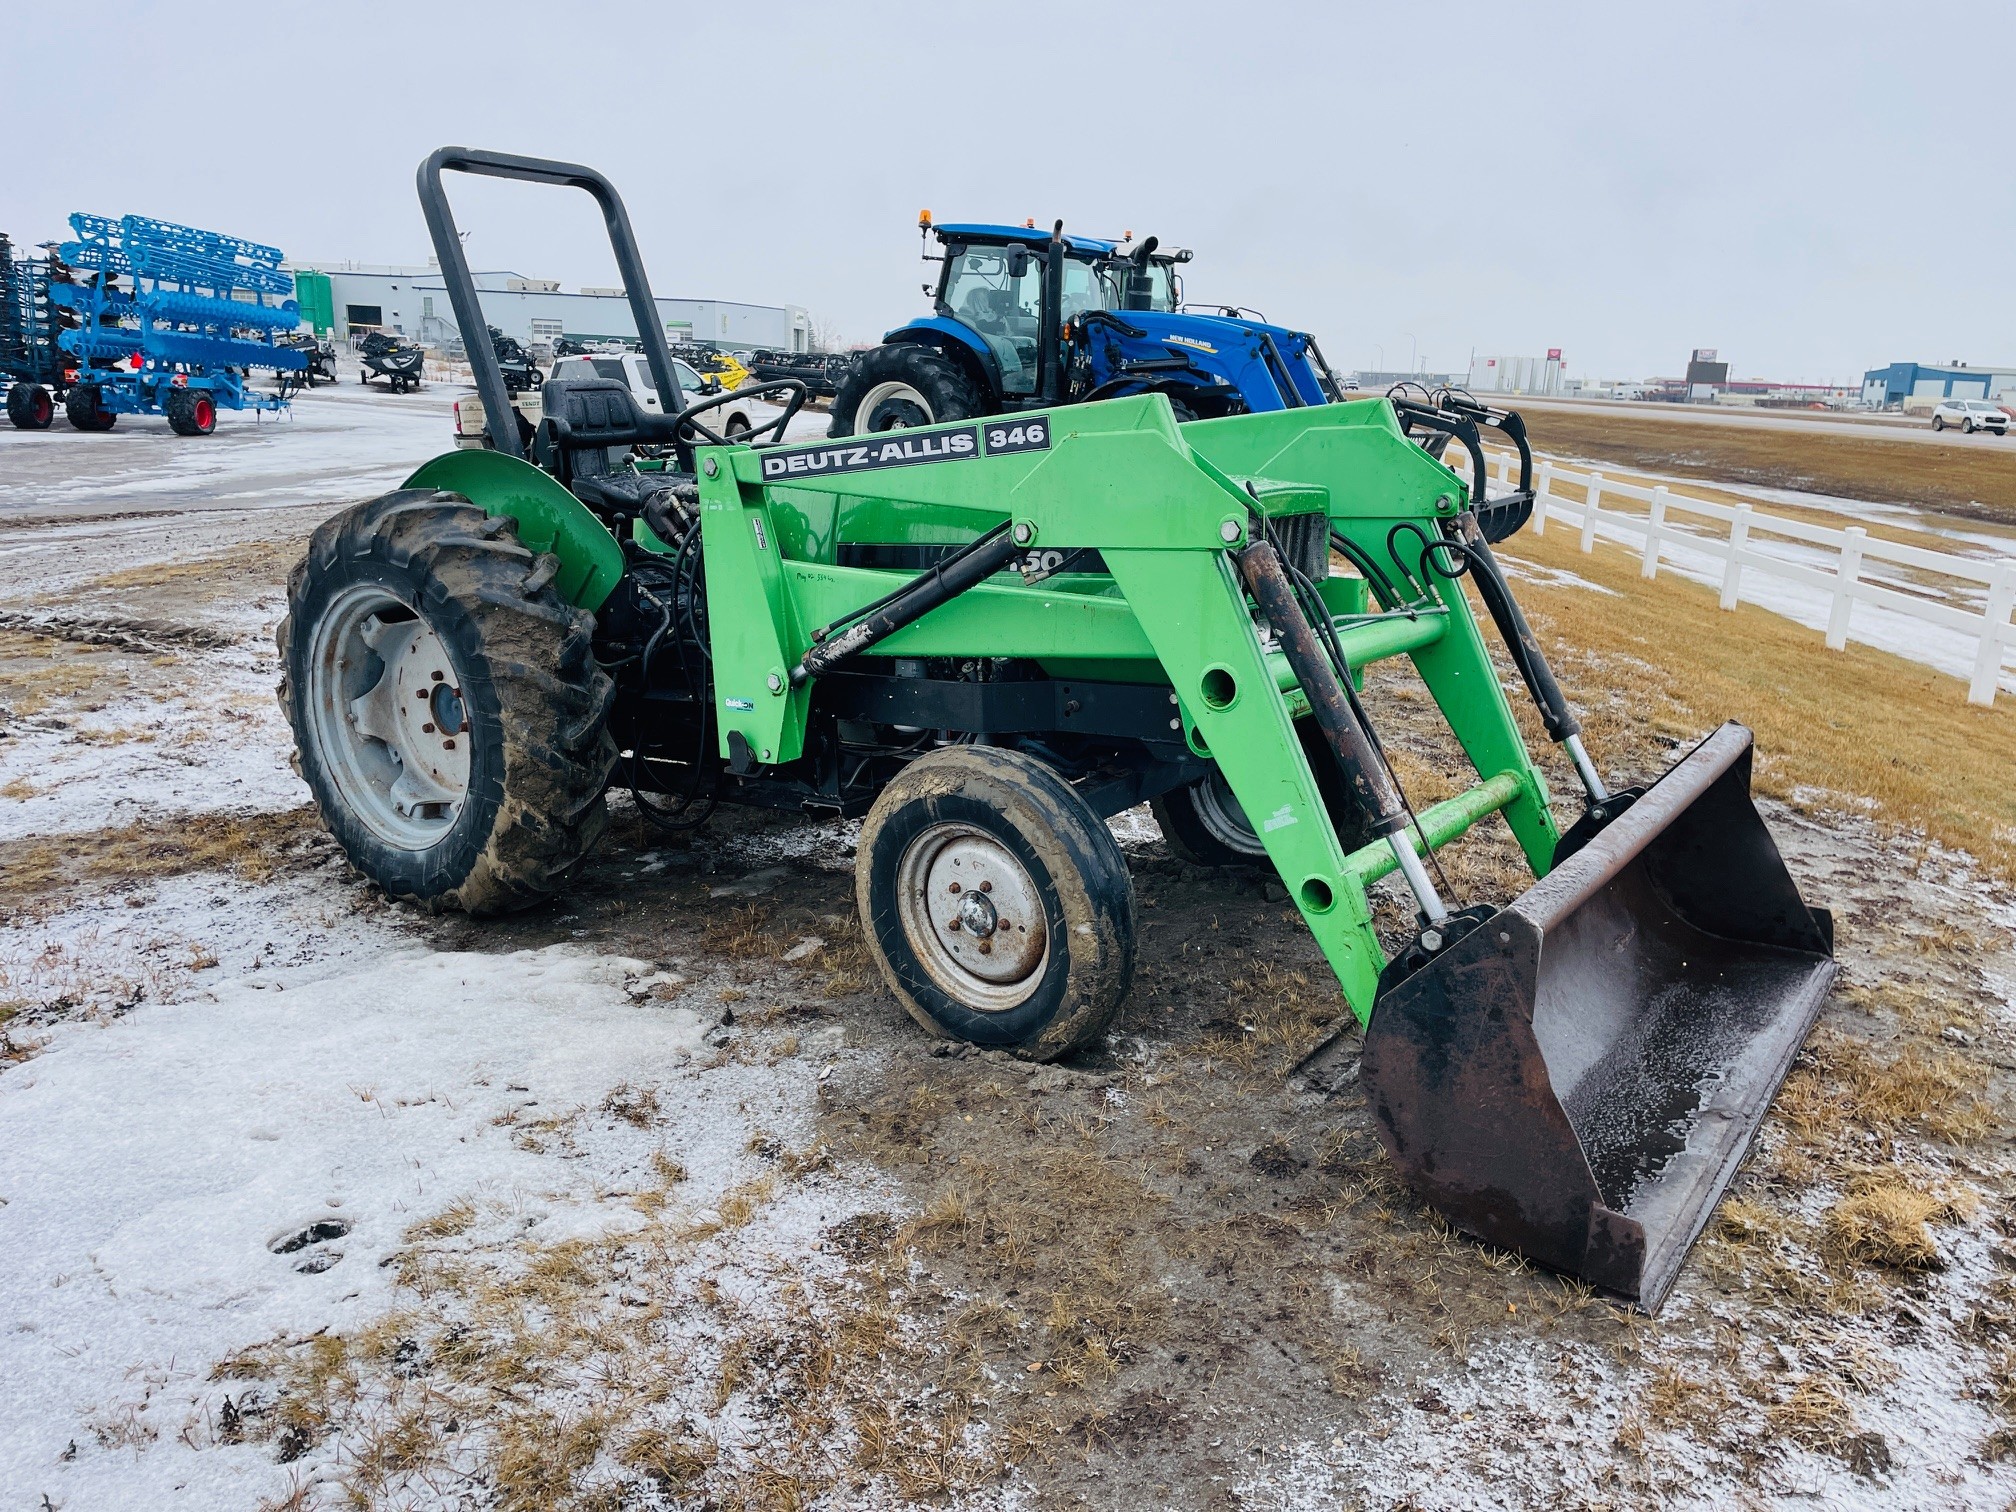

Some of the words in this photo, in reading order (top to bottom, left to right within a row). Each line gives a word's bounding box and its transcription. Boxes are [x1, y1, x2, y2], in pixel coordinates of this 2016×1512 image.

[1169, 334, 1183, 342] NEW
[1184, 337, 1211, 348] HOLLAND
[765, 433, 974, 476] DEUTZ-ALLIS
[989, 424, 1045, 448] 346
